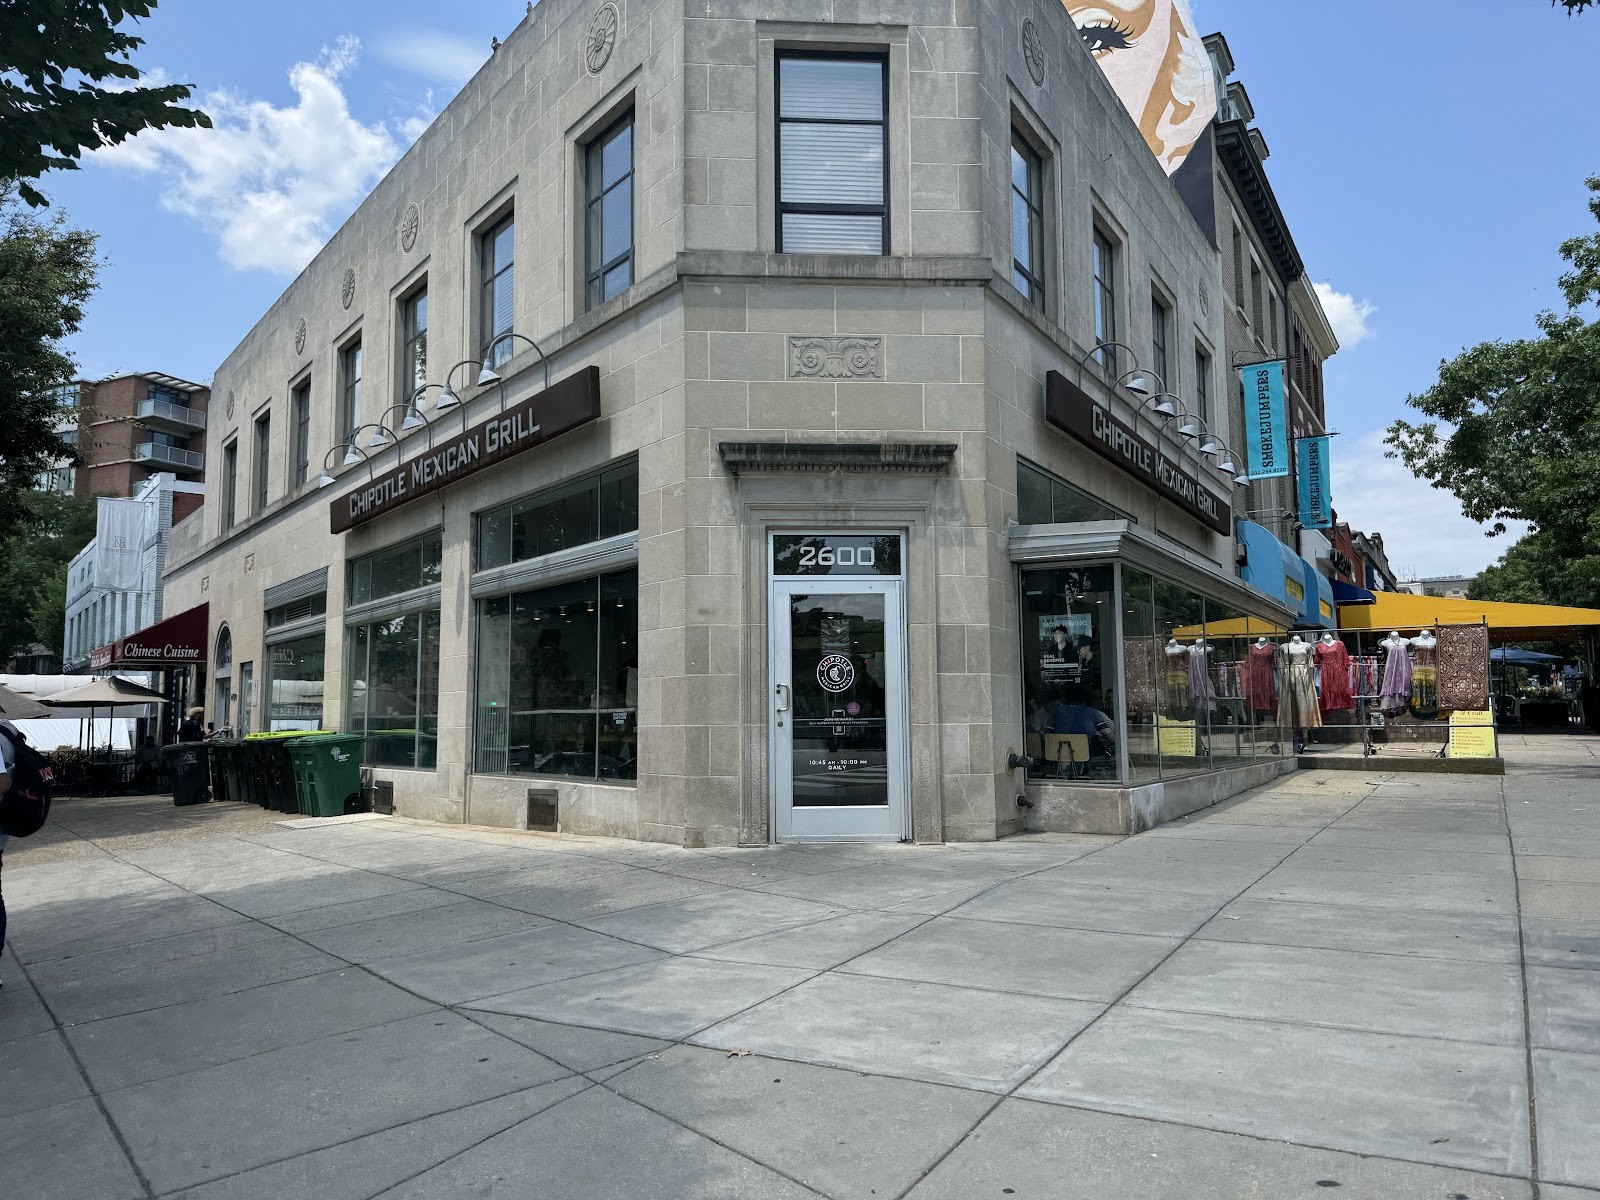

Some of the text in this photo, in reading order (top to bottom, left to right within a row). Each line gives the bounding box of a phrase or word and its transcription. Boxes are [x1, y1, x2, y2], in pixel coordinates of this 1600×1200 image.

[1257, 369, 1274, 468] SMOKEJUMPERS
[350, 407, 540, 518] CHIPOTLE MEXICAN GRILL
[1092, 404, 1220, 521] CHIPOTLE MEXICAN GRILL
[1309, 442, 1321, 520] SMOKEJUMPERS
[799, 546, 875, 566] 2600
[124, 643, 161, 657] Chinese
[164, 643, 199, 658] Cuisine
[820, 657, 851, 670] CHIPOTLE
